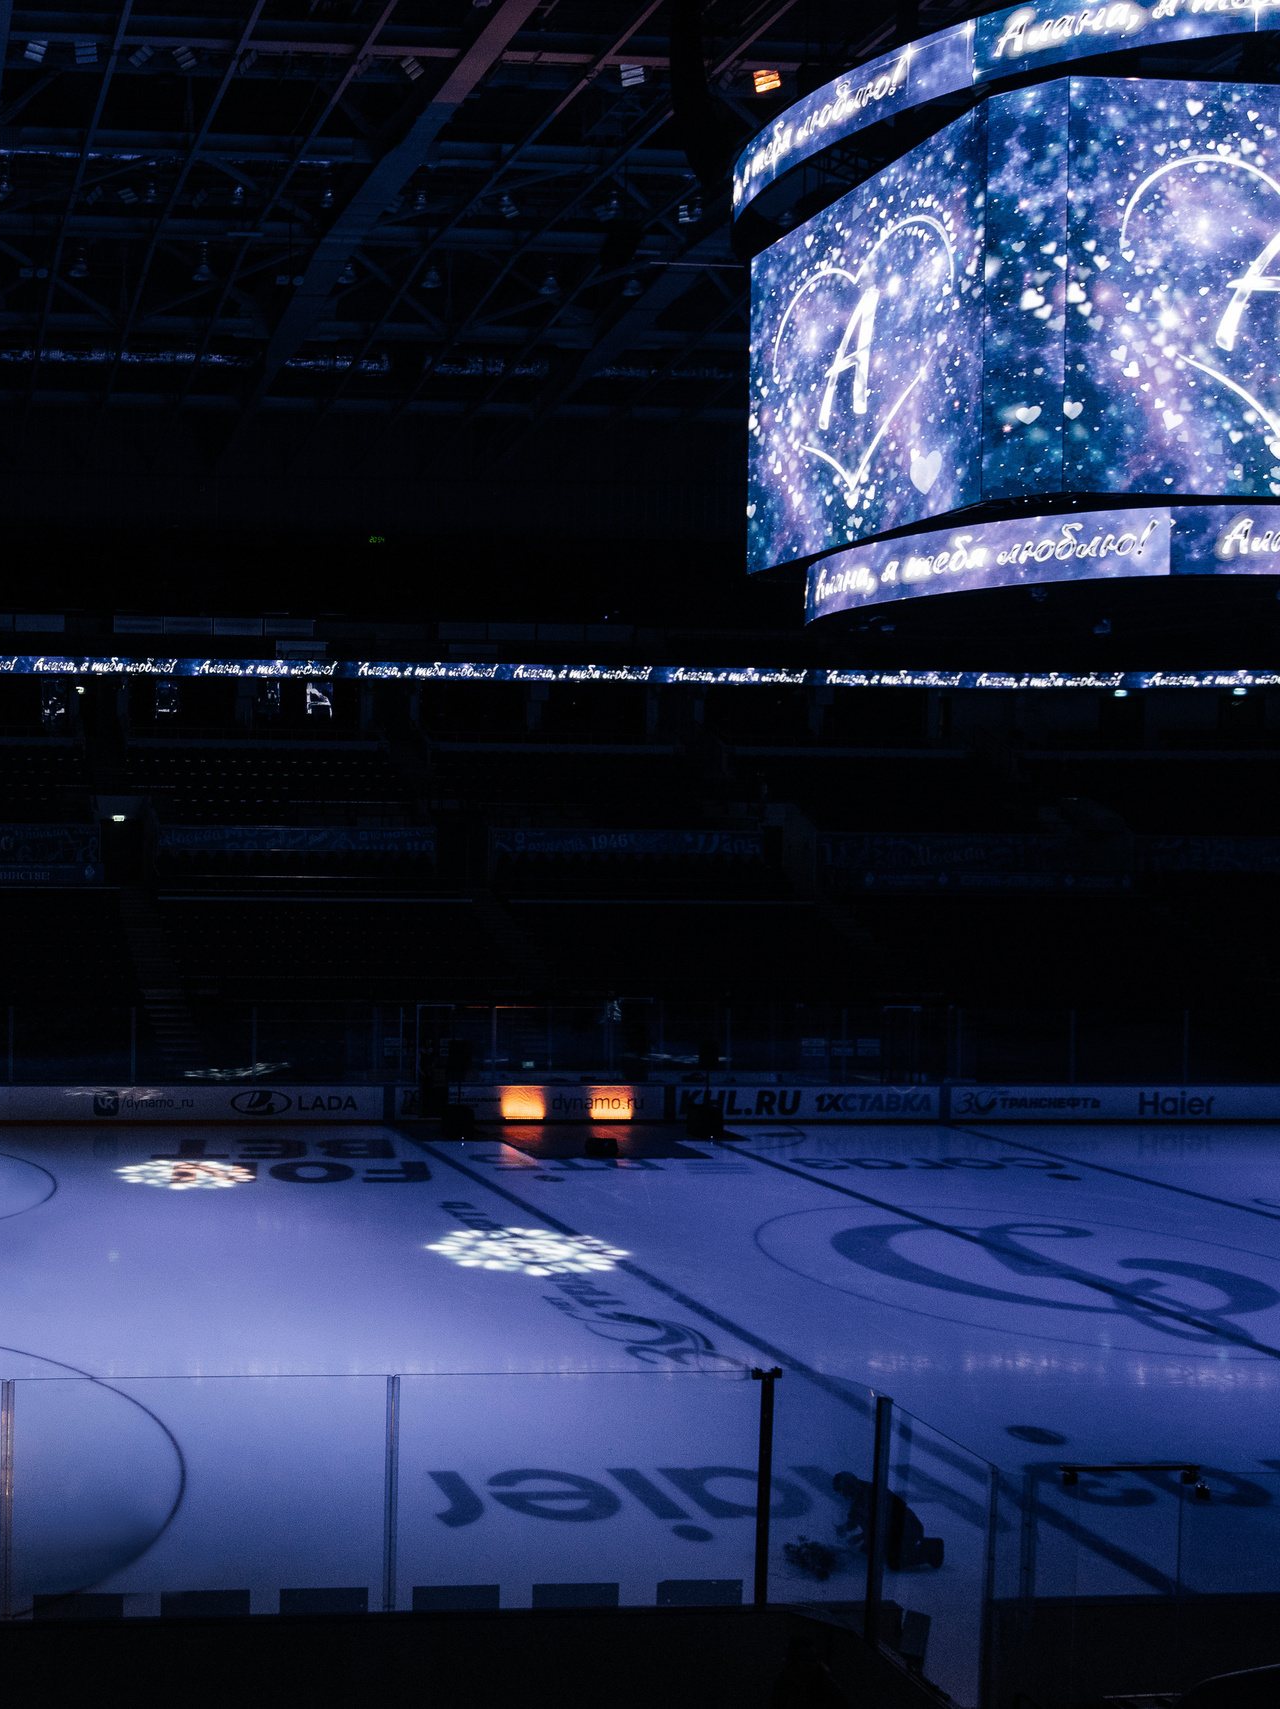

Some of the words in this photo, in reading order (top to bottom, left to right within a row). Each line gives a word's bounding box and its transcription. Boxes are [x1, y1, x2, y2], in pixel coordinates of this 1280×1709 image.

[993, 5, 1140, 58] Алана,
[905, 535, 988, 578] тебя
[997, 519, 1159, 565] люблю!
[33, 658, 77, 673] Алана,
[92, 657, 122, 672] тебя
[297, 1095, 359, 1111] LADA
[552, 1094, 645, 1114] dynamo.ru
[1000, 1097, 1101, 1110] ТРАНСНЕФТЬ
[1138, 1090, 1216, 1116] Haier
